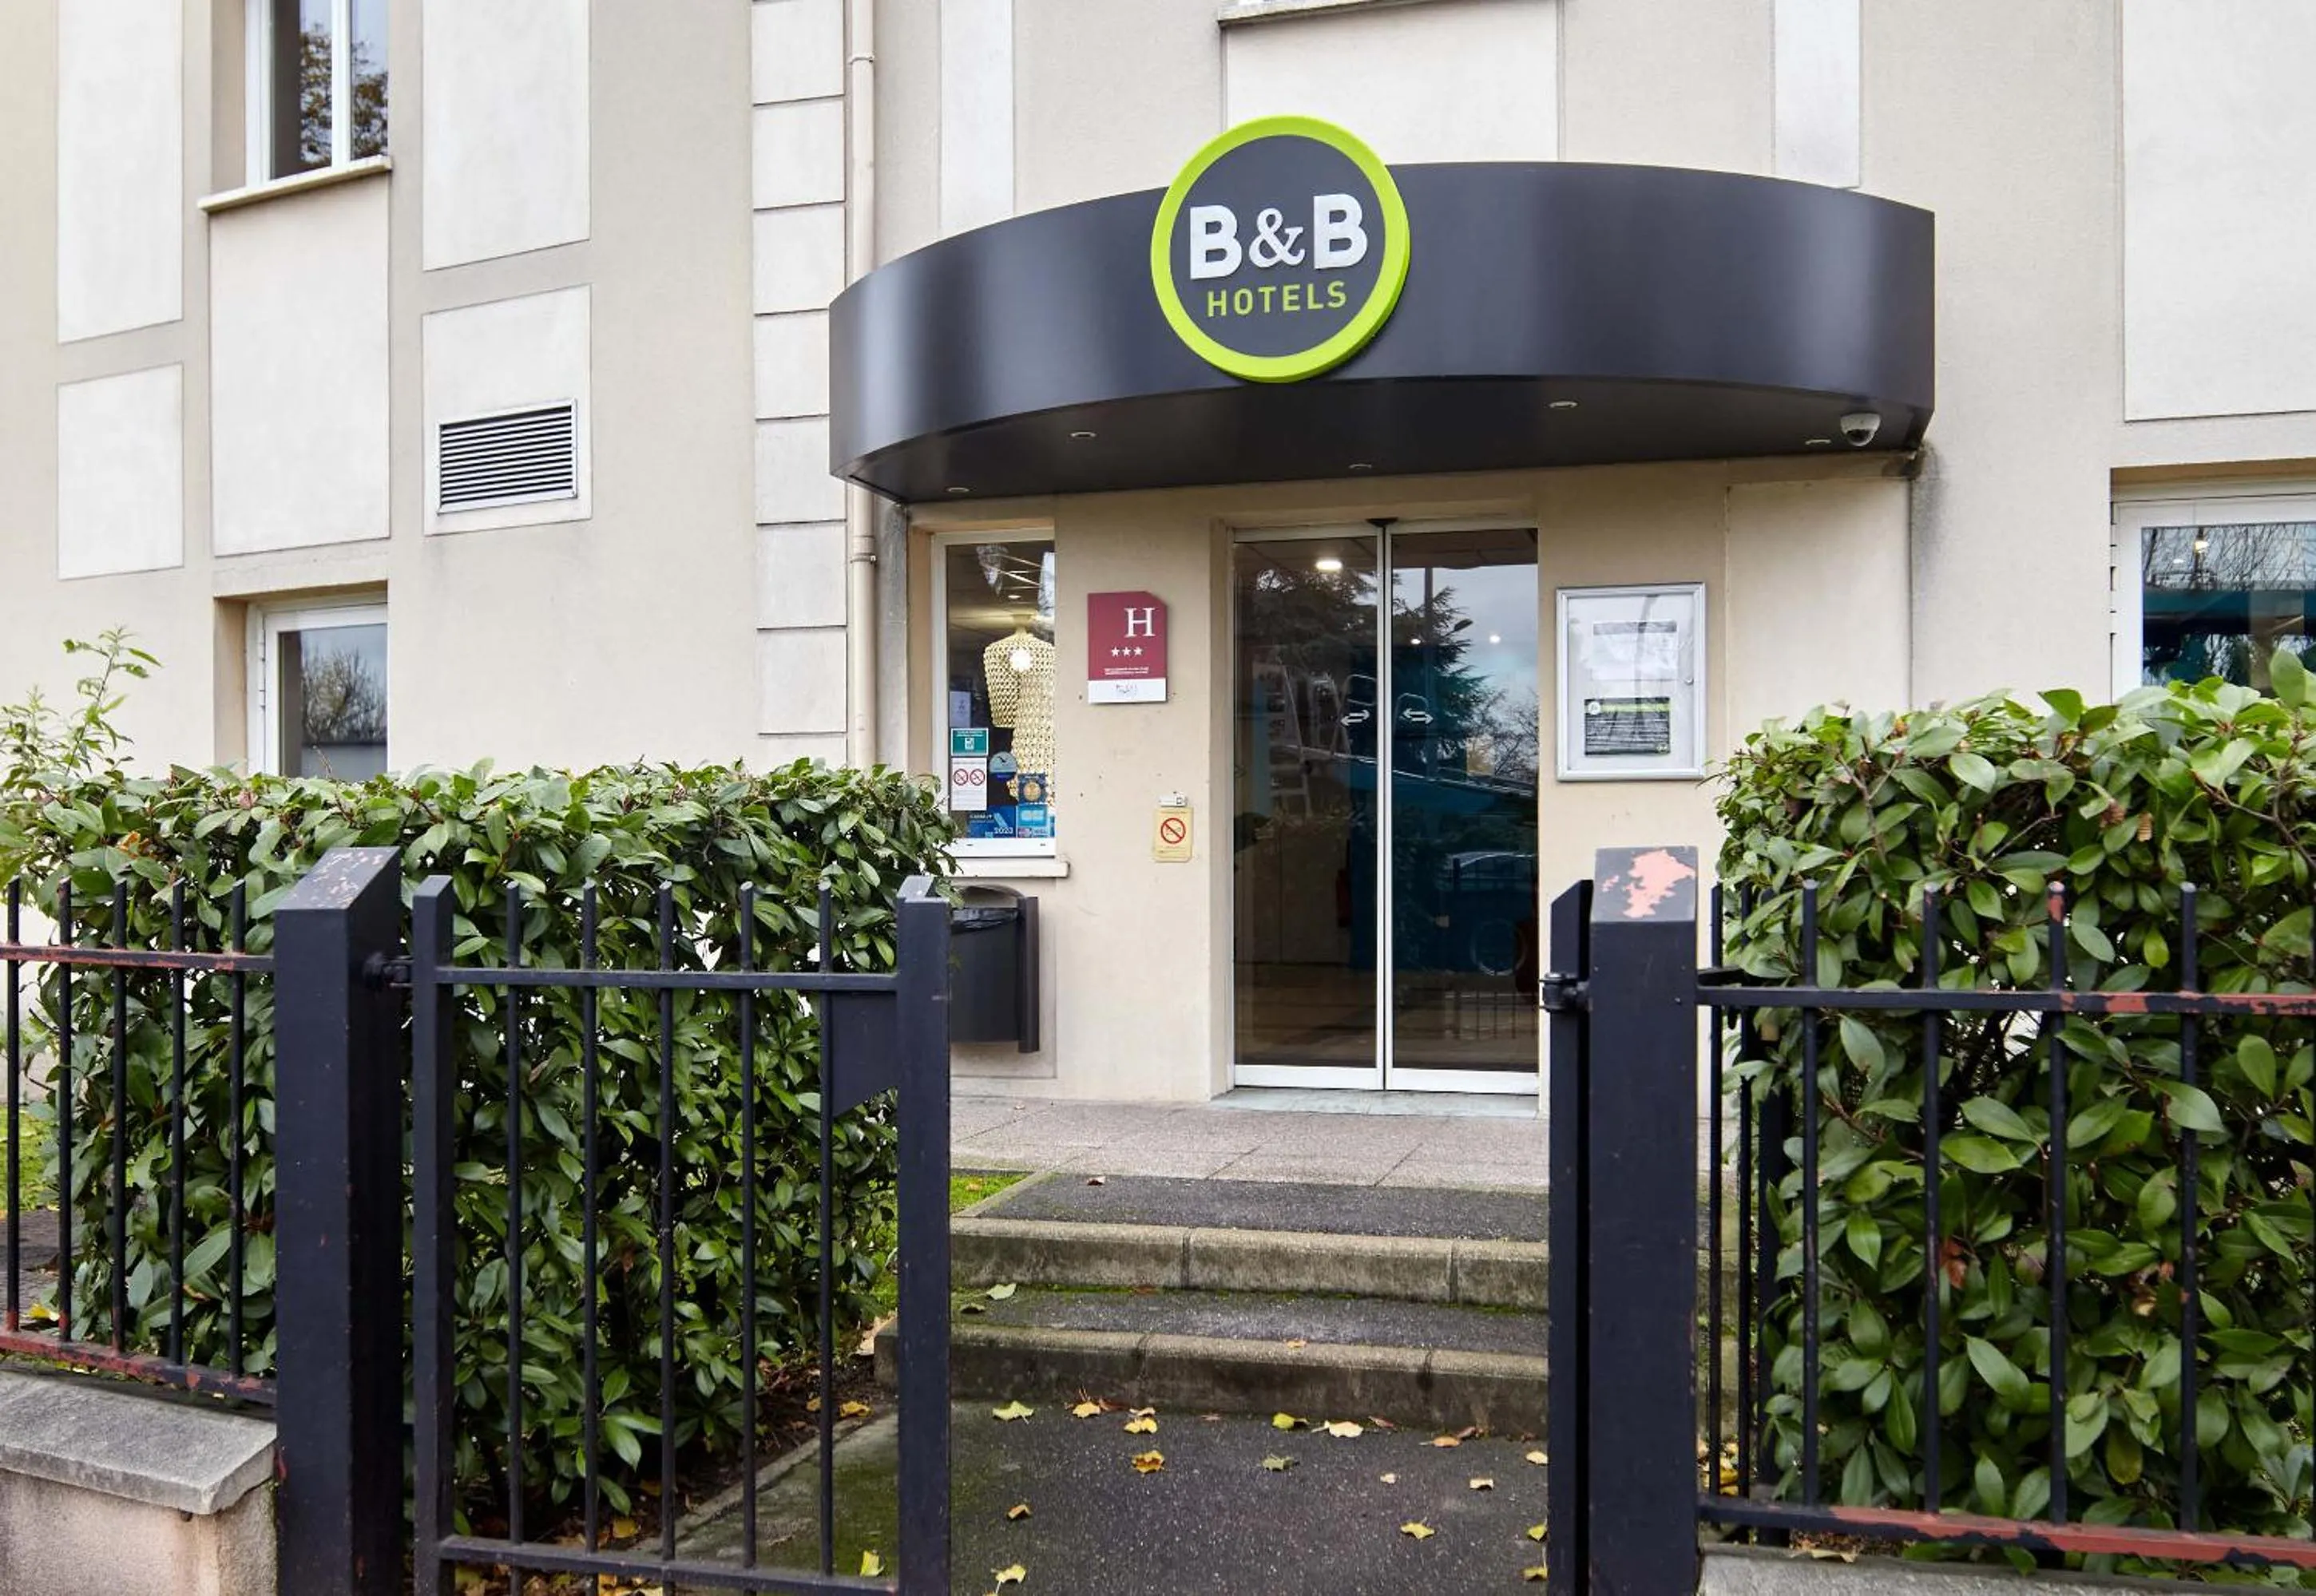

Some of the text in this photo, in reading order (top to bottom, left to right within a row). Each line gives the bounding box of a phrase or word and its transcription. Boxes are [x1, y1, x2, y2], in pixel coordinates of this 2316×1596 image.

[1190, 194, 1368, 279] B&B
[1207, 281, 1347, 317] HOTELS
[1124, 608, 1156, 637] H
